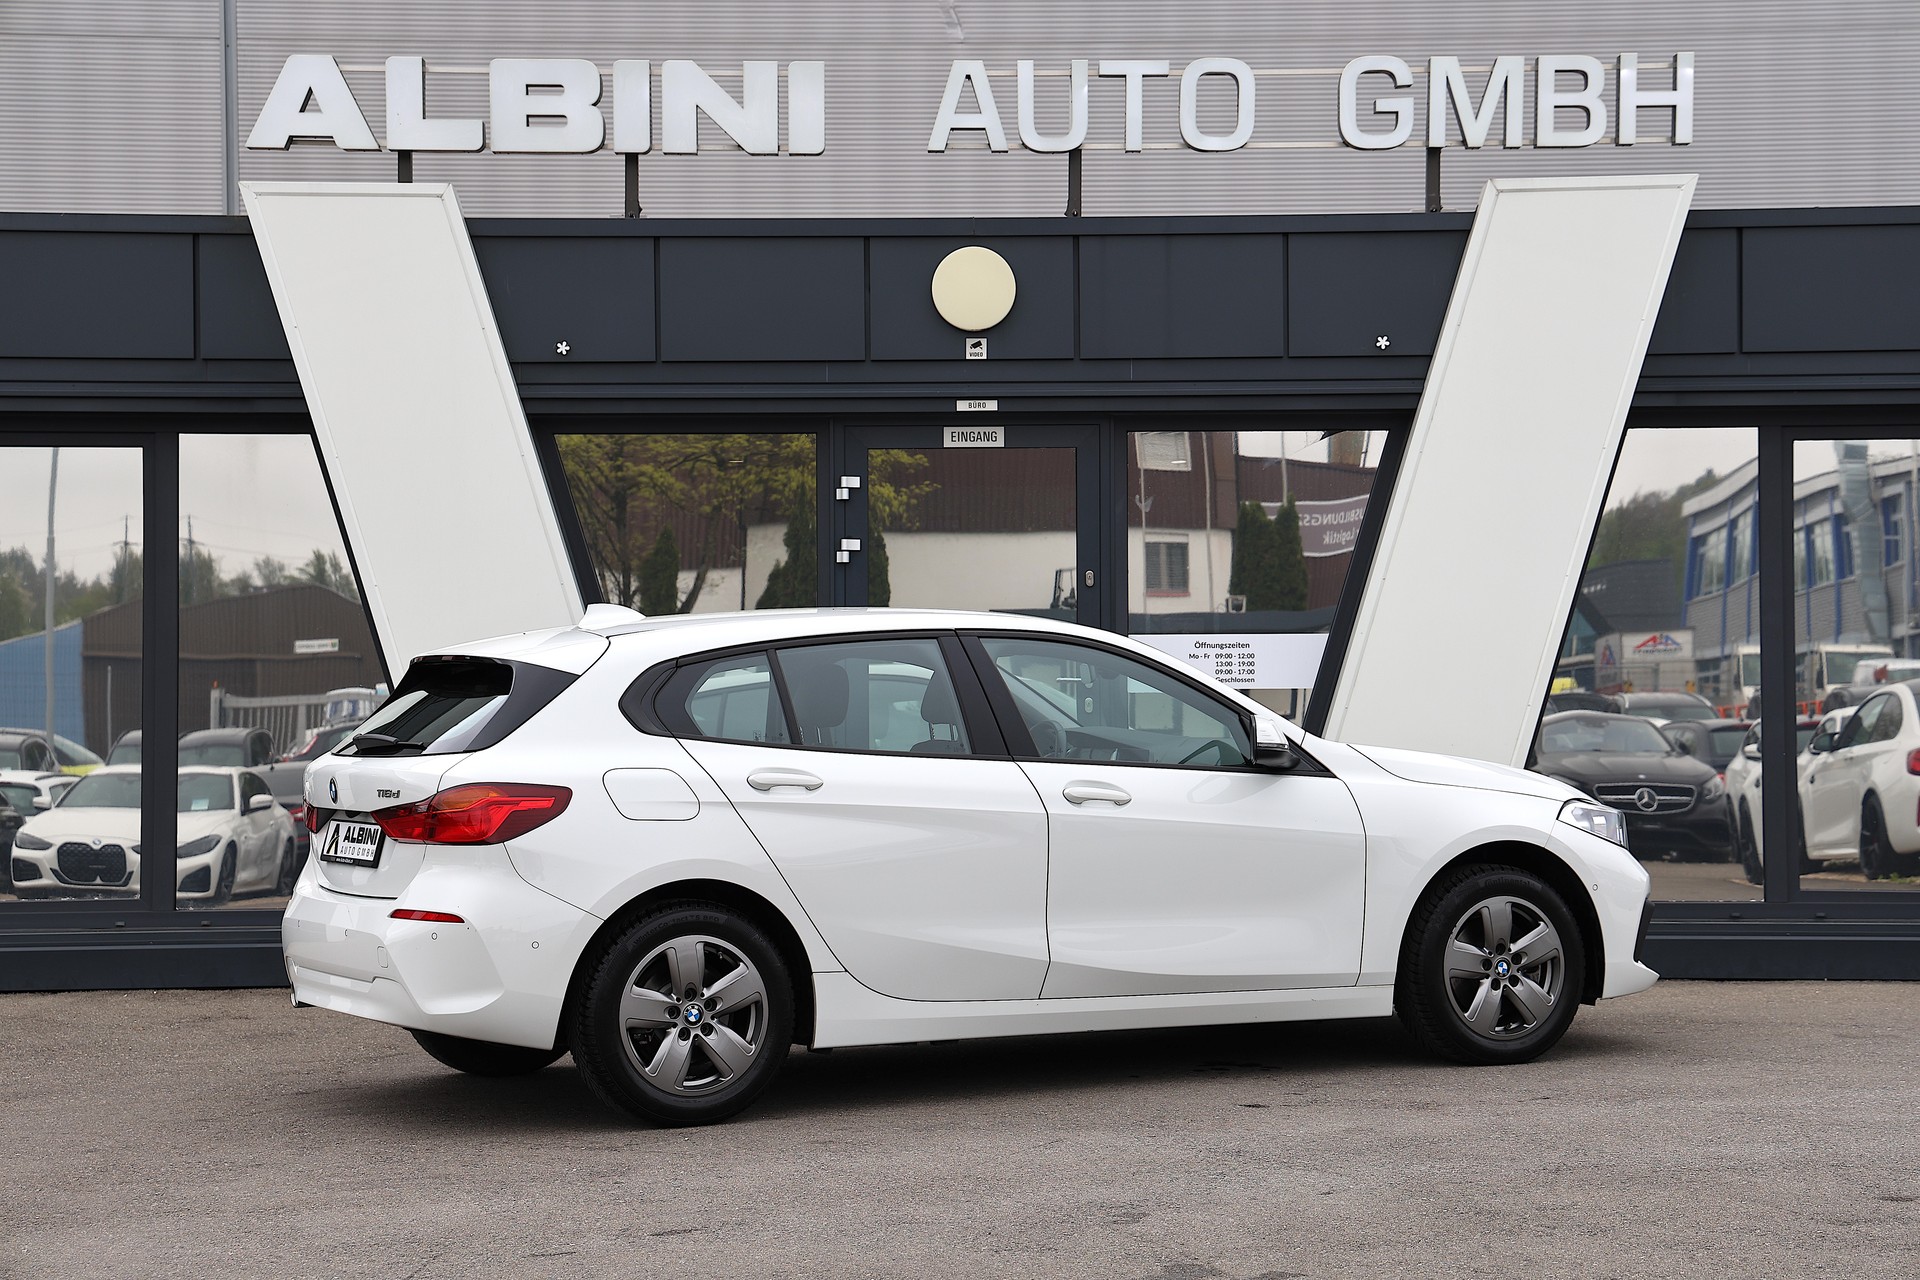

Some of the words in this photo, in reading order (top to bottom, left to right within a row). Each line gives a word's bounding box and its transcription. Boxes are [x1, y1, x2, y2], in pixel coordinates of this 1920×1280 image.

[245, 54, 826, 155] ALBINI
[927, 57, 1256, 153] AUTO
[1338, 51, 1695, 150] GMBH
[968, 401, 987, 409] BÜRO
[950, 430, 998, 443] EINGANG
[1194, 640, 1250, 650] Öffnungszeiten
[343, 826, 379, 846] ALBINI
[340, 846, 356, 856] AUTO
[356, 847, 375, 858] GMBH
